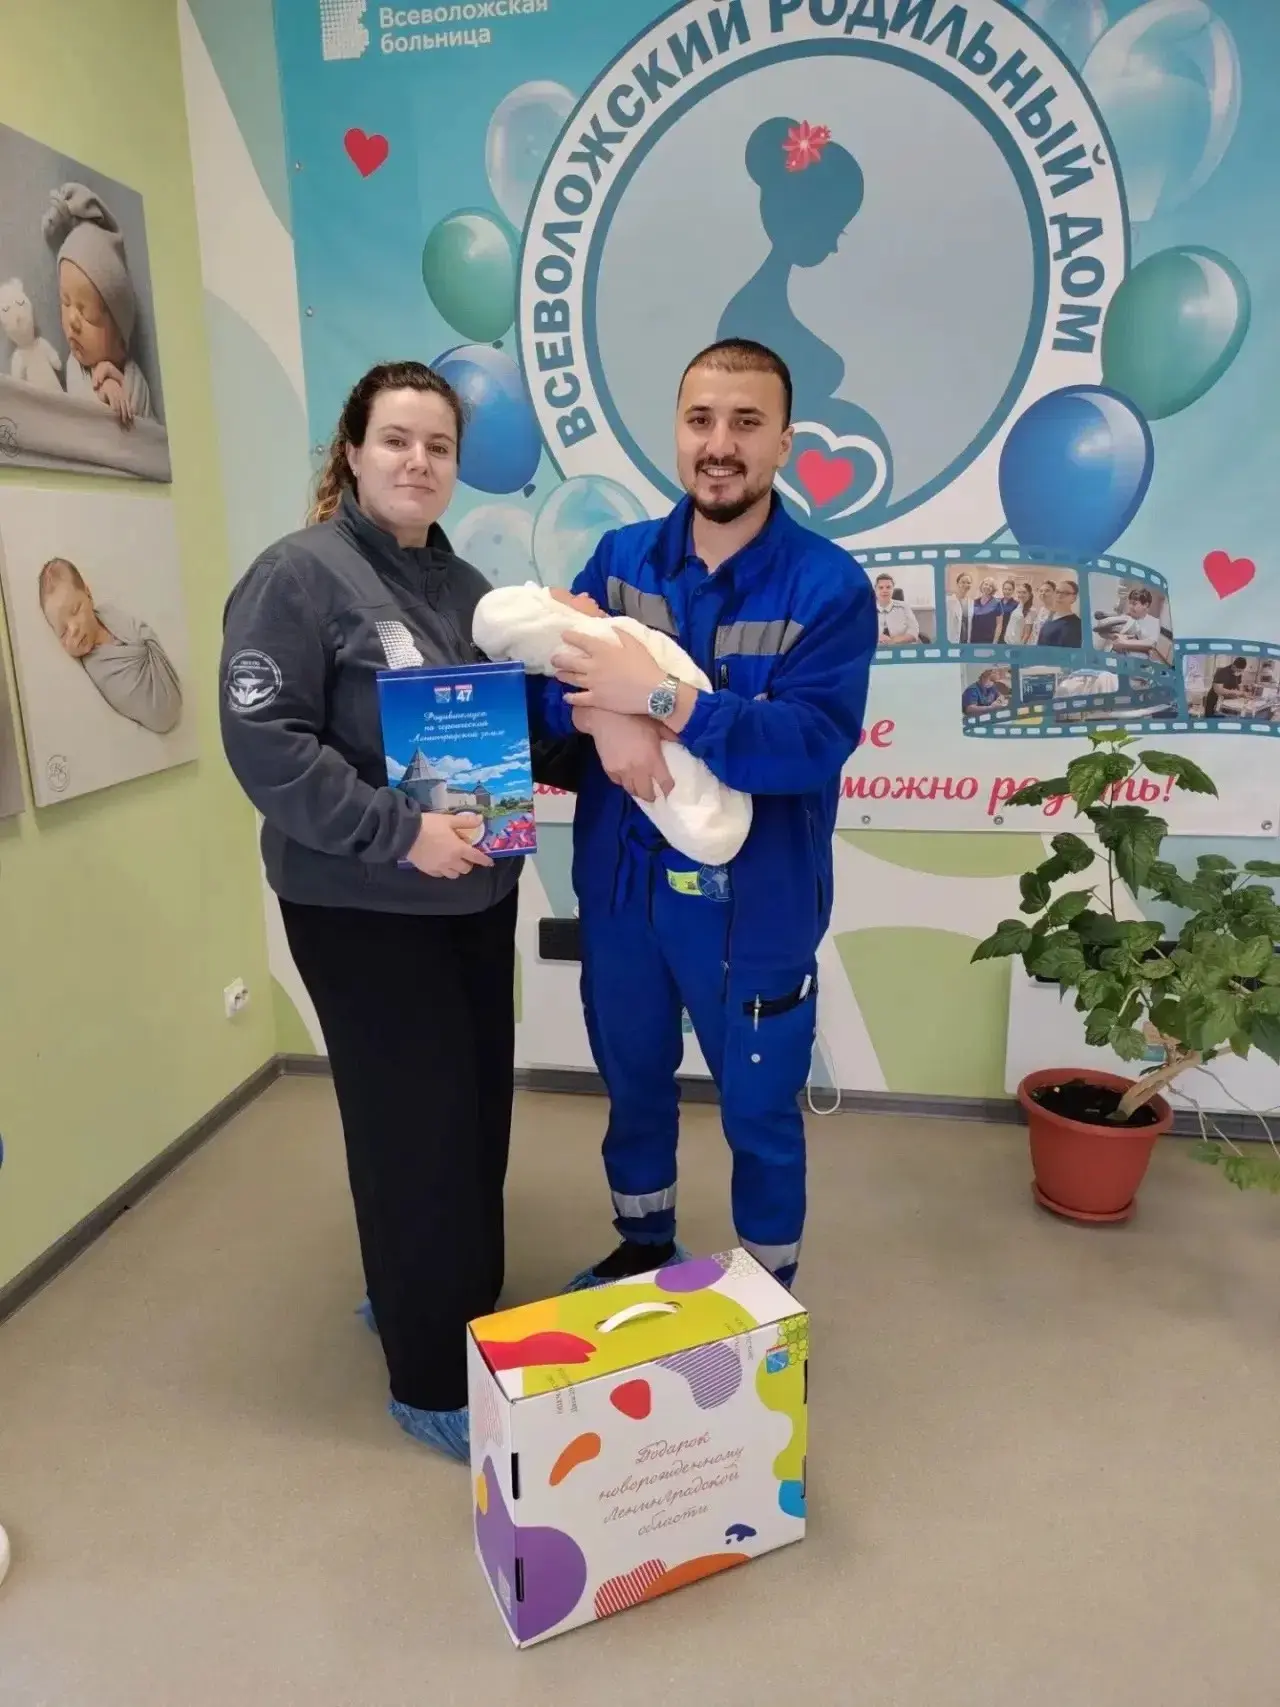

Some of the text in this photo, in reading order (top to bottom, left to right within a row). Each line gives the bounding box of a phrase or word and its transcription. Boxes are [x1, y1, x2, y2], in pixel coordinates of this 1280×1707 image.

[379, 0, 548, 28] Всеволожская
[380, 27, 492, 54] больница
[533, 0, 1106, 448] ВСЕВОЛОЖСКИЙ РОДИЛЬНЫЙ ДОМ
[456, 690, 472, 702] 47
[840, 776, 978, 800] можно
[635, 1431, 711, 1464] Подарок
[599, 1447, 744, 1500] новорожденному
[603, 1462, 740, 1524] Ленинградской
[637, 1505, 709, 1536] области
